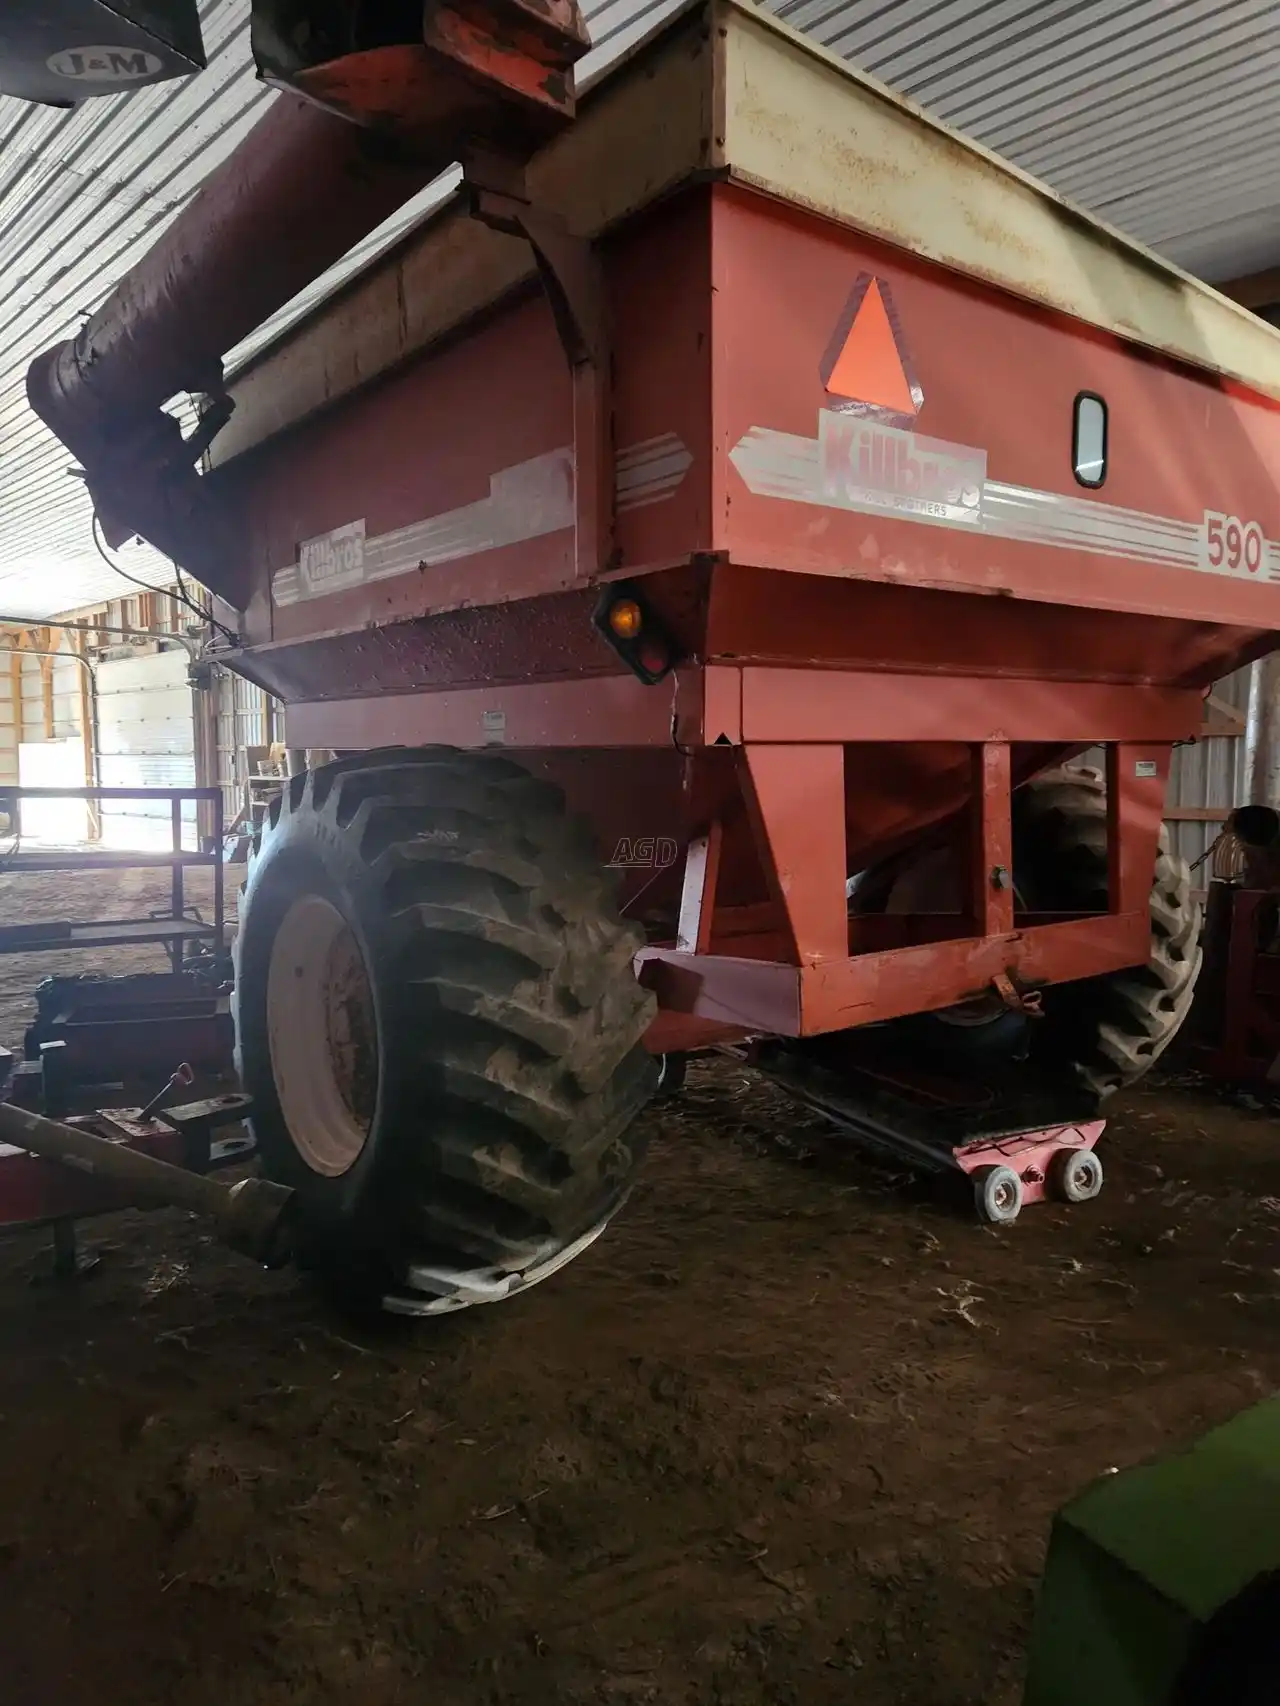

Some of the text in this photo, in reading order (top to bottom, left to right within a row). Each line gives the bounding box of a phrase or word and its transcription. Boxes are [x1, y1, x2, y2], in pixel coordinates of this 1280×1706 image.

[55, 53, 148, 75] J&M
[825, 421, 981, 507] Killbr
[1207, 518, 1262, 573] 590
